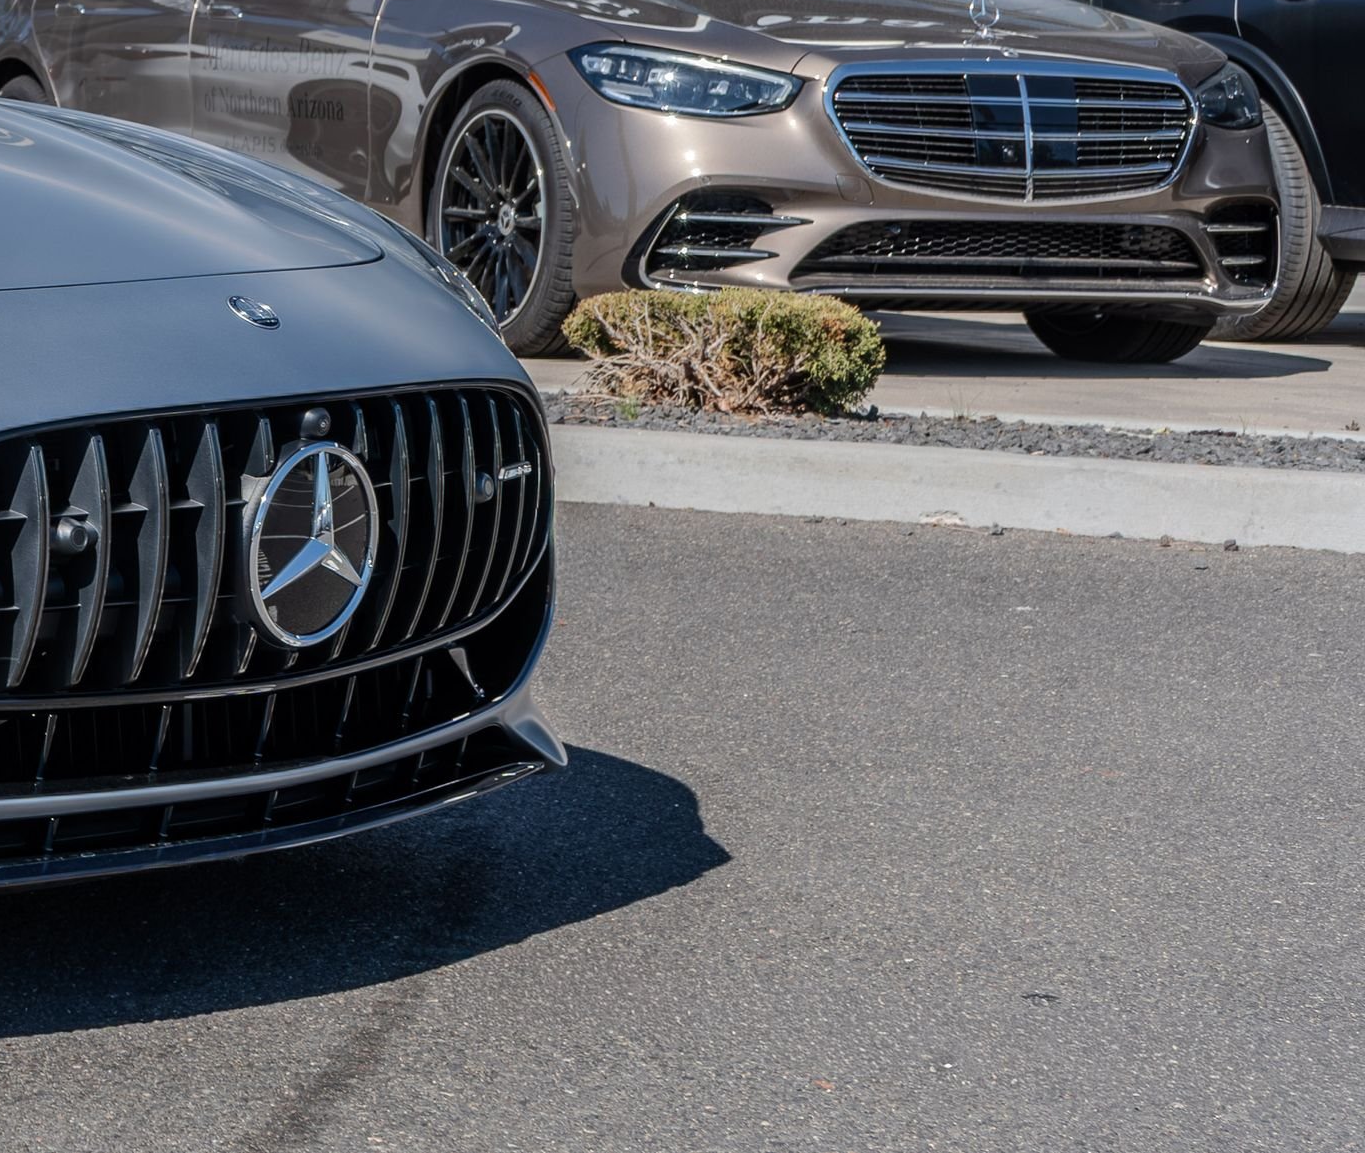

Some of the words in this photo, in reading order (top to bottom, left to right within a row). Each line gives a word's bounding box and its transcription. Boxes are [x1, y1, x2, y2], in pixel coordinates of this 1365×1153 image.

[203, 31, 348, 77] Mercedes-Benz
[204, 86, 217, 113] of
[219, 87, 281, 115] Northern
[287, 91, 344, 121] Arizona
